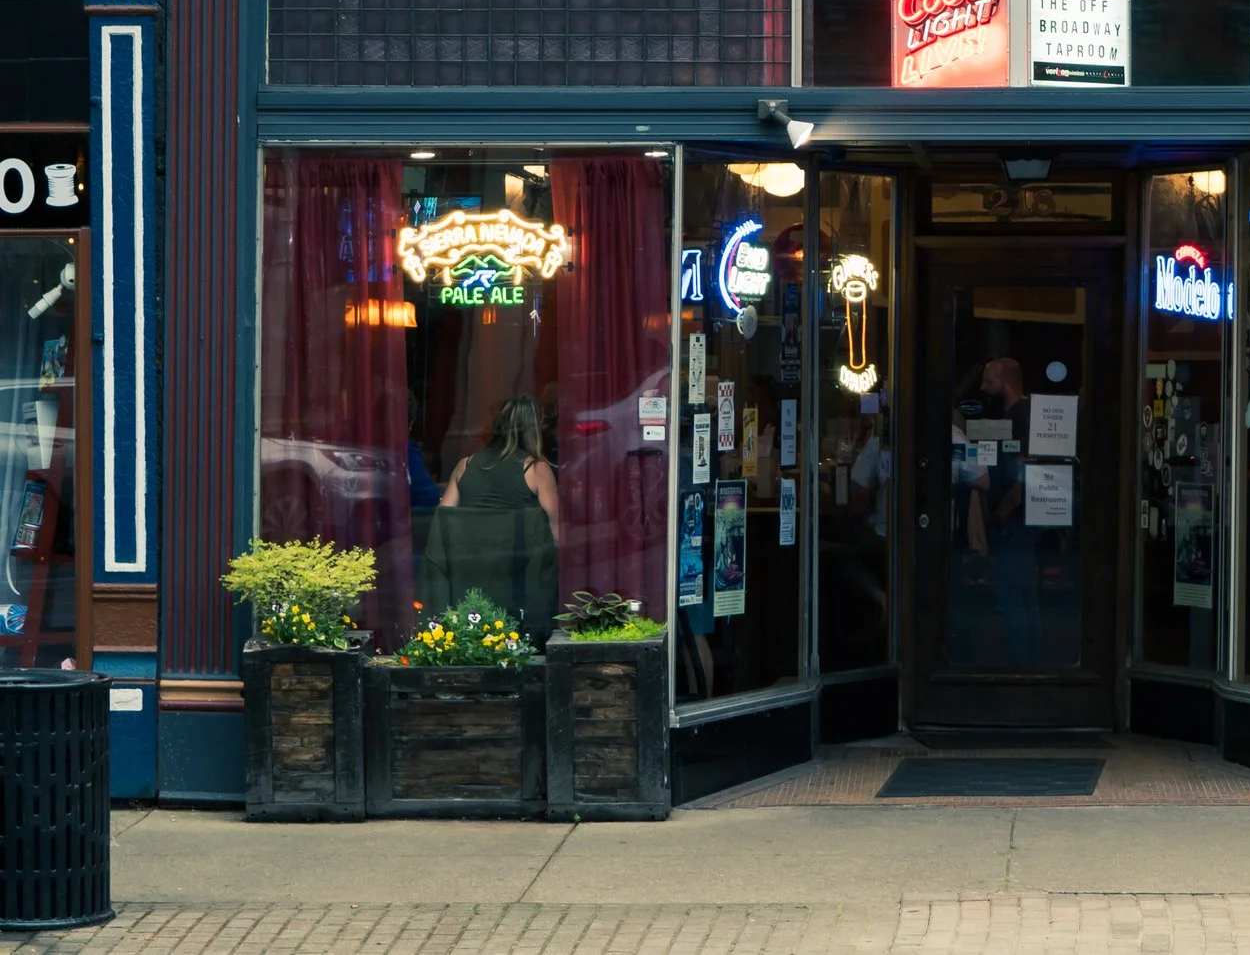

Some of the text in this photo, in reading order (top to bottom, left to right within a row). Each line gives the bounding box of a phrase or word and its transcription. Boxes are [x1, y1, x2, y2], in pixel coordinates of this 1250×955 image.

[1079, 0, 1108, 13] OFF
[1039, 19, 1121, 37] BROADWAY
[1046, 42, 1118, 61] TAPROOM
[418, 222, 546, 257] SIERRA NEVADA
[728, 265, 771, 296] LIGHT
[832, 253, 879, 291] GUESS
[441, 286, 524, 304] PALE ALE
[1155, 255, 1220, 320] Modelo
[1047, 422, 1057, 431] 21
[1036, 432, 1069, 440] PERMITTED
[1031, 495, 1067, 503] Restrooms
